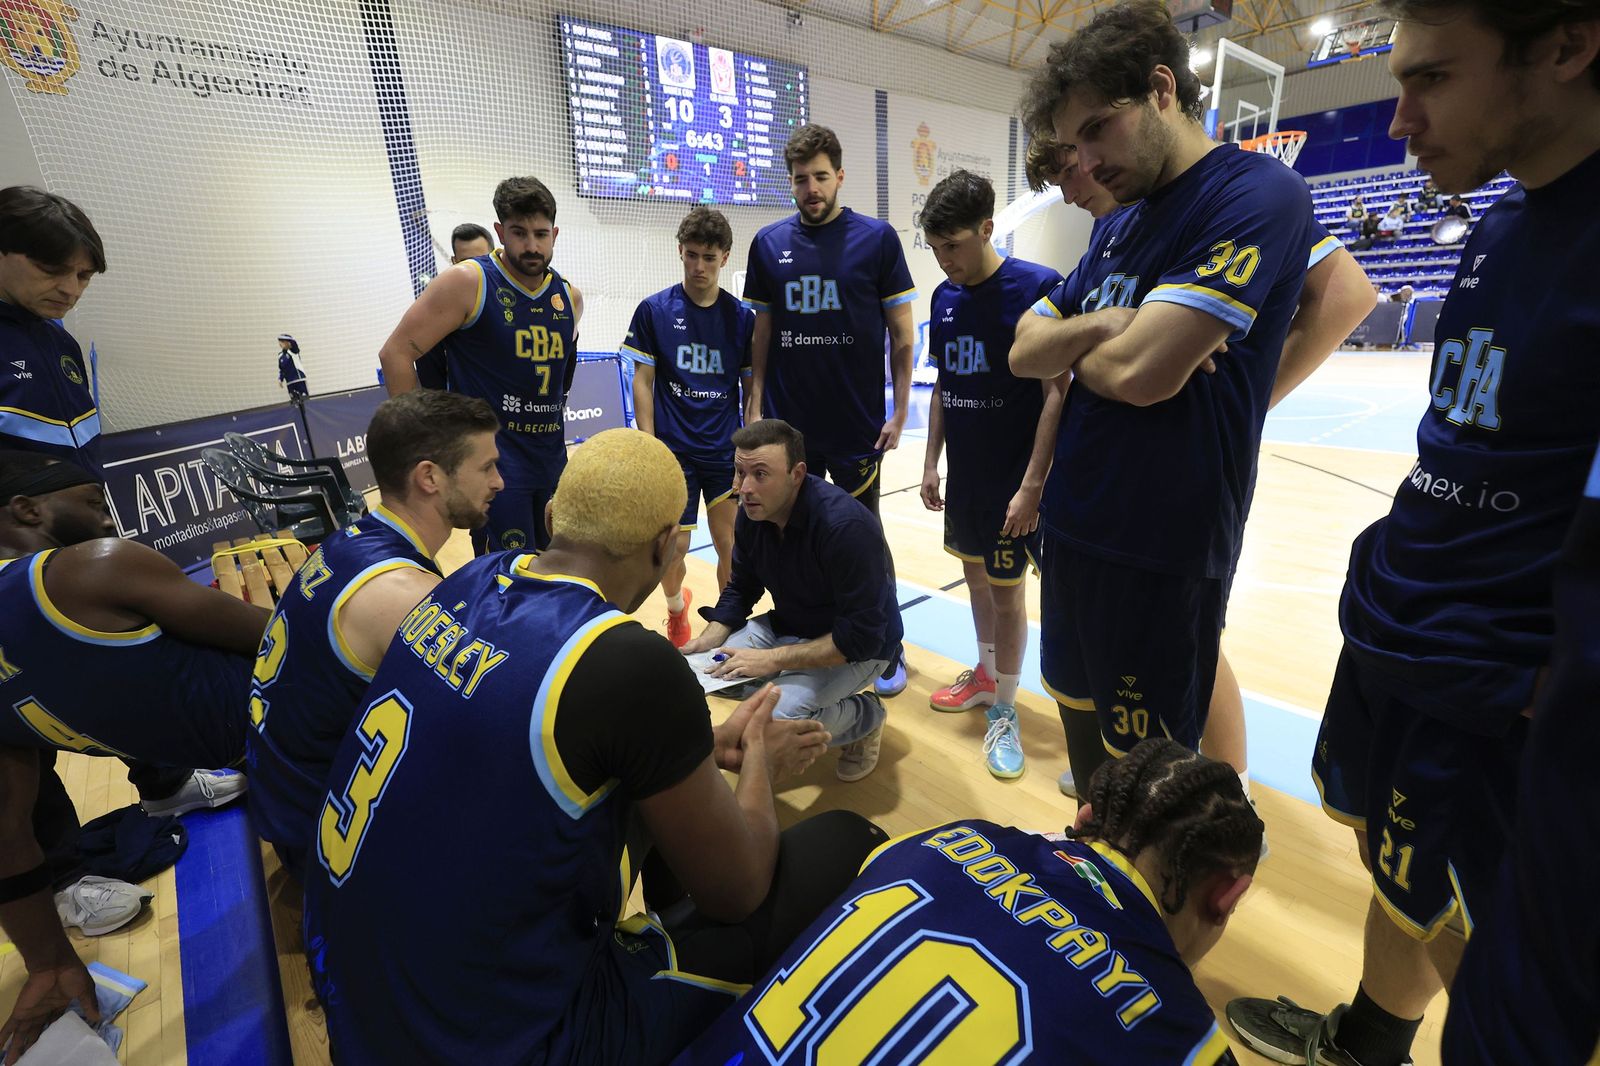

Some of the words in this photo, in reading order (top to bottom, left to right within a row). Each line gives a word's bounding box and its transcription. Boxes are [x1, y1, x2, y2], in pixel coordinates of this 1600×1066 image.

[92, 19, 309, 75] Ayuntamiento
[97, 55, 140, 81] de
[152, 60, 312, 105] Algeciras
[665, 97, 694, 123] 10
[719, 106, 733, 129] 3
[686, 130, 724, 151] 6:43
[1194, 238, 1262, 288] 30
[785, 274, 842, 314] CBA
[1459, 274, 1480, 289] vive
[515, 325, 564, 362] CBA
[794, 332, 854, 345] damex.io
[945, 335, 991, 375] CBA
[676, 342, 725, 374] CBA
[13, 371, 33, 379] vive
[535, 365, 551, 395] 7
[952, 395, 1004, 409] damex.io
[993, 550, 1015, 569] 15
[1117, 689, 1143, 701] vive
[1112, 705, 1149, 738] 30
[317, 688, 414, 888] 3
[1379, 827, 1415, 893] 21
[920, 826, 1163, 1032] EDOKPAYI
[744, 879, 1034, 1066] 10
